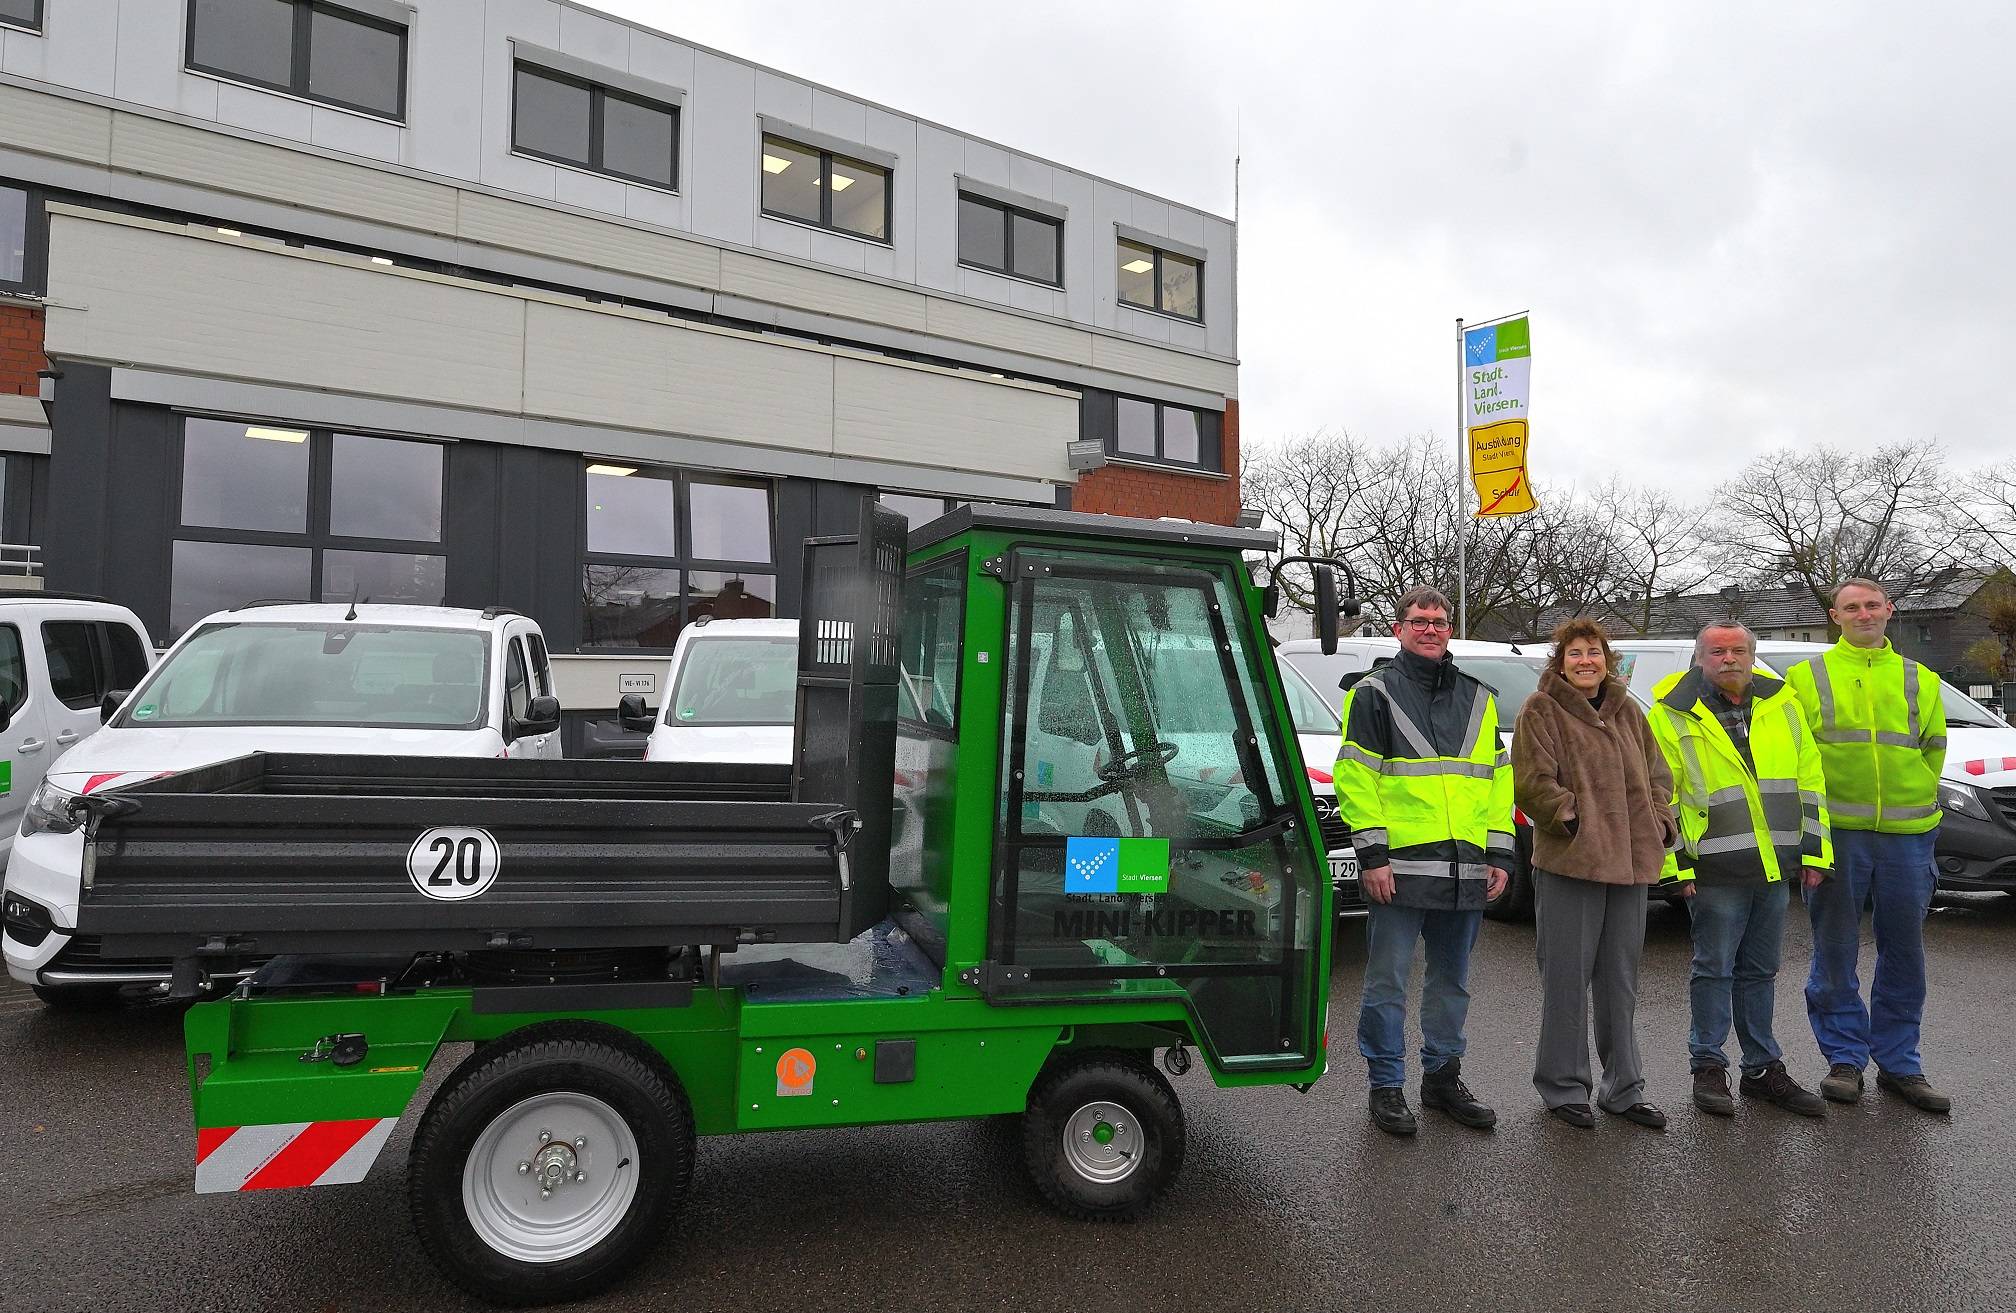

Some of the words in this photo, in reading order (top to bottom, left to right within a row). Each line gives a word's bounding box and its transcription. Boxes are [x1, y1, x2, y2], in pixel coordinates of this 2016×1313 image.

[1473, 398, 1523, 416] Viersen.
[428, 837, 481, 886] 20
[1340, 862, 1356, 877] 29
[1053, 910, 1257, 937] MINI-KIPPER
